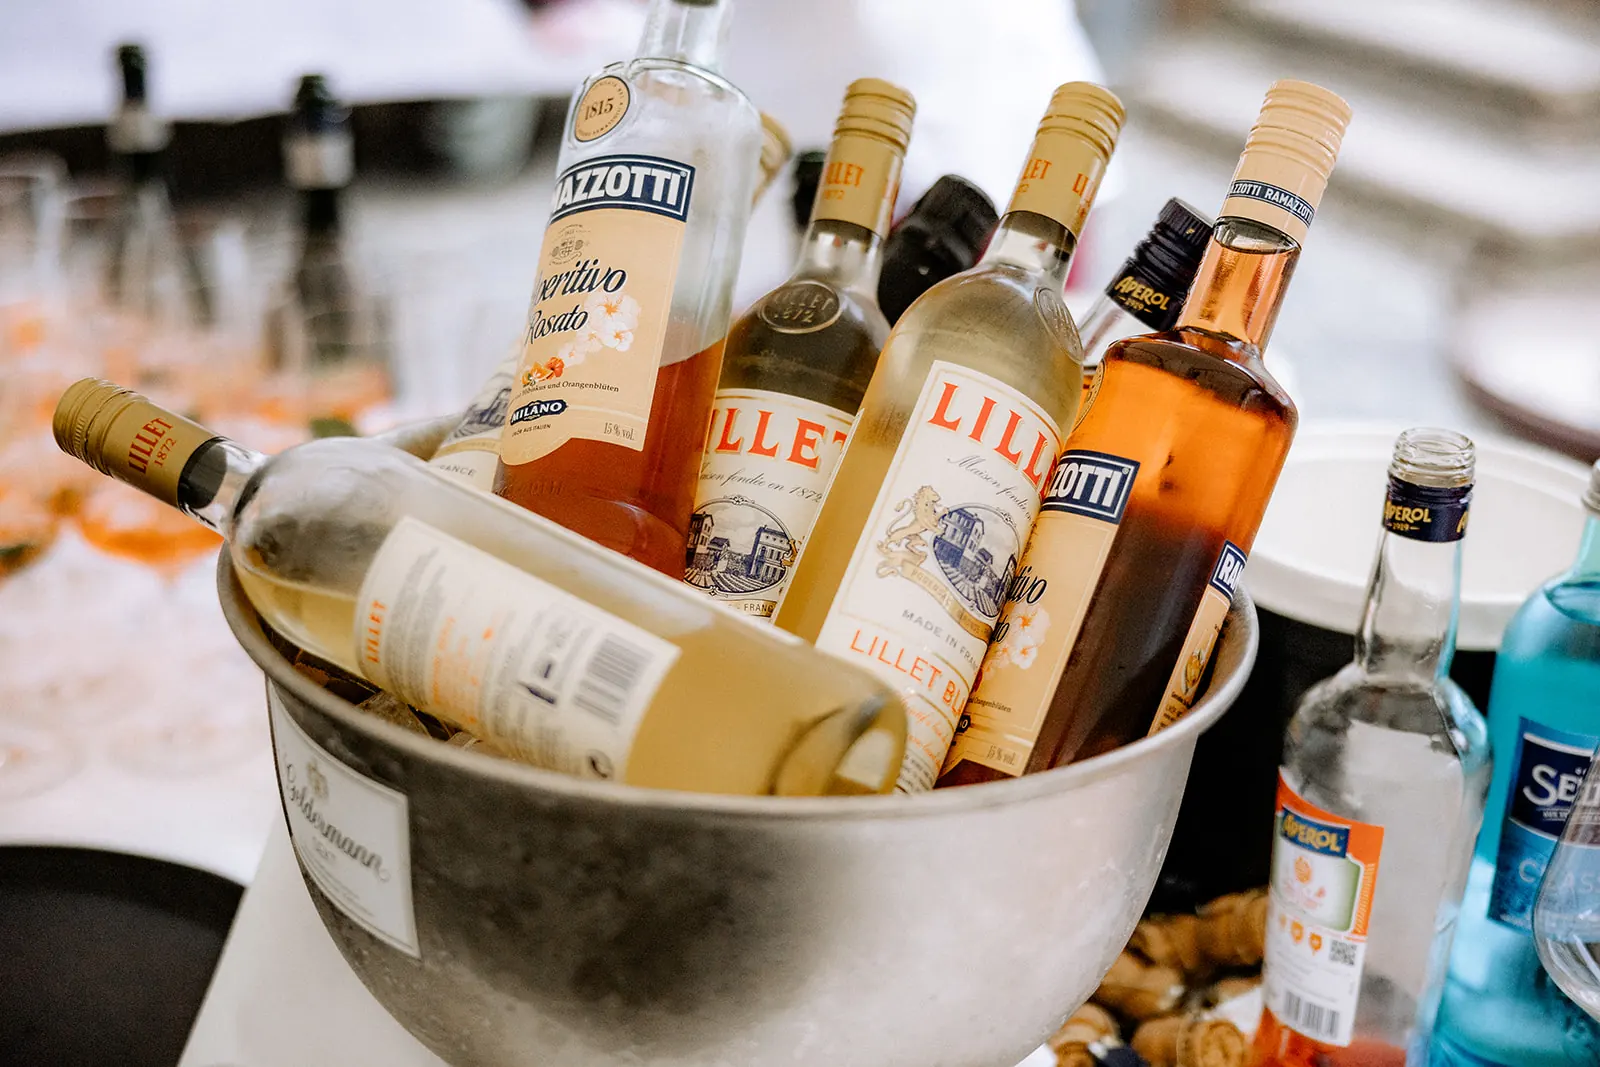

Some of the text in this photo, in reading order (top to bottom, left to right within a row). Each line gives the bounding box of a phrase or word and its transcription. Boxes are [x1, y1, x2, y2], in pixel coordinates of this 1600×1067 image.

[585, 97, 614, 121] 1815
[1023, 159, 1052, 180] LET
[1114, 276, 1170, 310] APEROL
[547, 382, 561, 390] und
[562, 380, 619, 393] Orangenblüten
[511, 402, 562, 422] MILANO
[128, 418, 173, 474] LILLET
[154, 438, 177, 468] 1872
[927, 381, 1057, 500] LILL
[946, 454, 1002, 488] Maison
[788, 486, 823, 503] 1872
[744, 603, 774, 613] FRANC
[366, 600, 387, 664] LILLET
[902, 608, 979, 670] MADE IN FRAN
[849, 629, 966, 717] LILLET BL
[1283, 814, 1341, 853] APEROL
